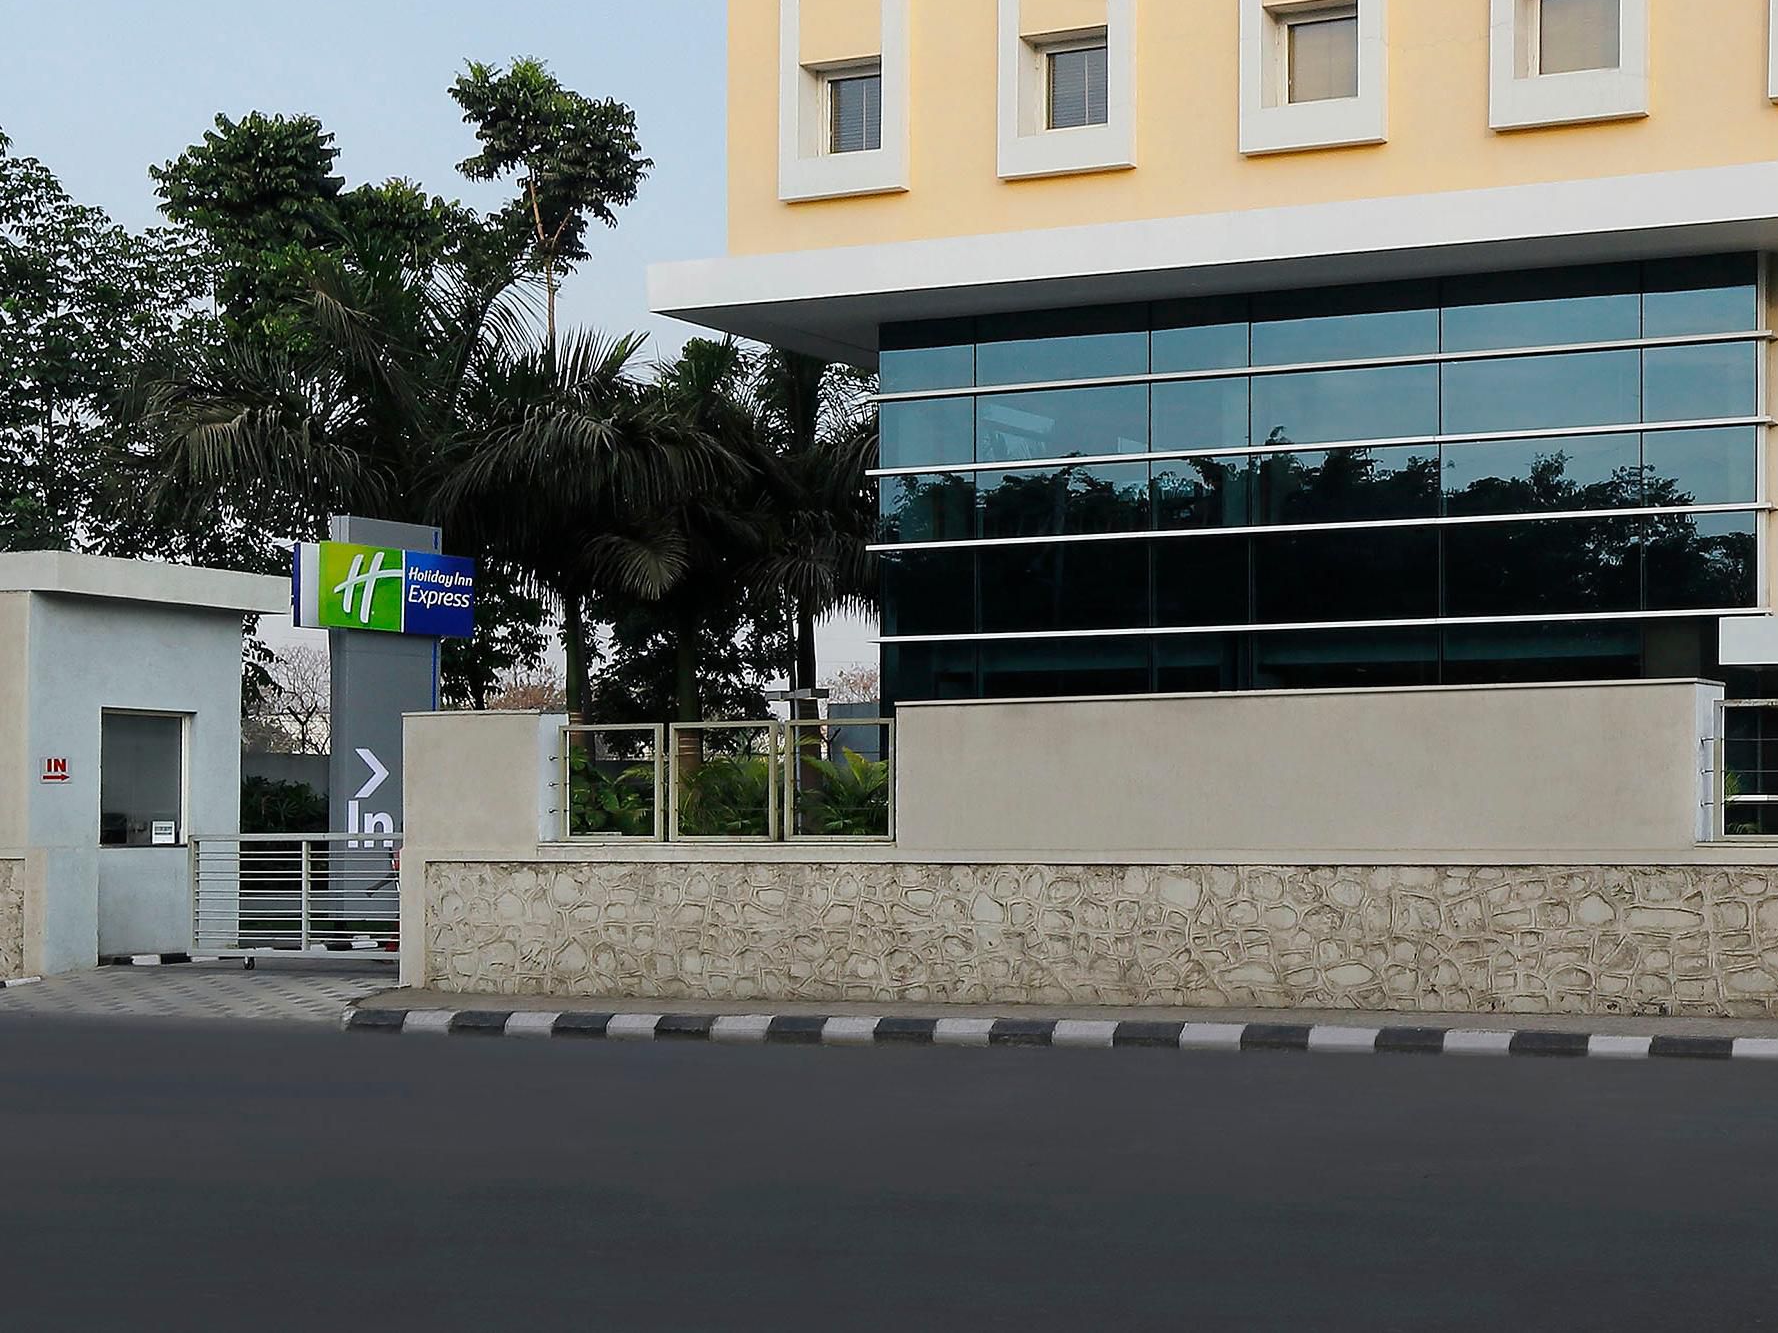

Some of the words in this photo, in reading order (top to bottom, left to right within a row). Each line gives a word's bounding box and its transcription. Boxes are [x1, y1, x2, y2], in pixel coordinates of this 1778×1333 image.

[408, 566, 453, 587] Holiday
[453, 571, 473, 587] Inn
[408, 585, 471, 610] Express
[47, 758, 67, 773] IN
[348, 800, 394, 848] In
